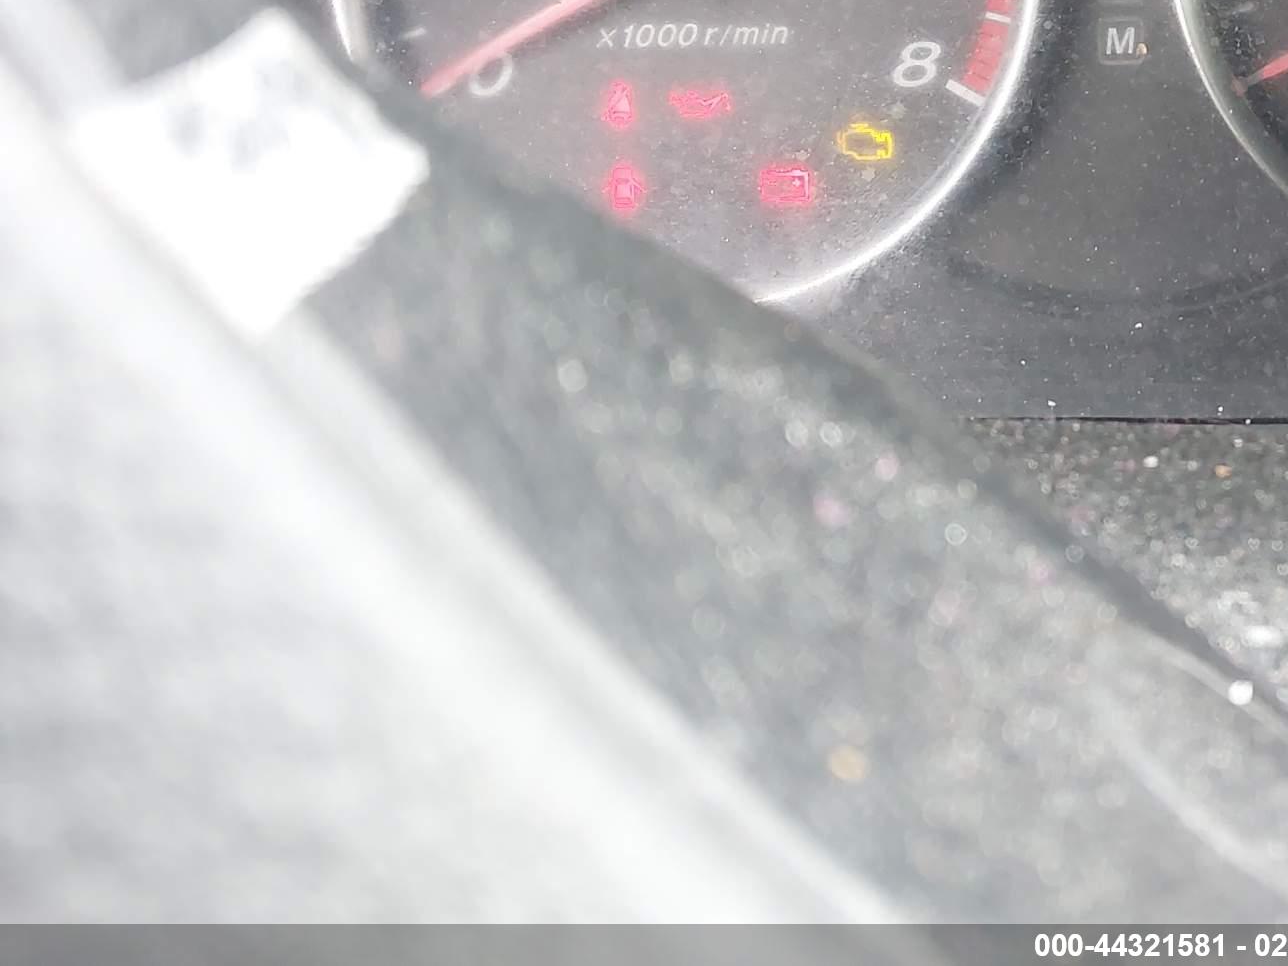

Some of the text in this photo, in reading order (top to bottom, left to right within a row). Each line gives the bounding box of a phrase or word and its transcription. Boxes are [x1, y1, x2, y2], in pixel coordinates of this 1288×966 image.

[1105, 27, 1136, 55] M
[466, 52, 515, 98] 0
[892, 41, 940, 89] 8
